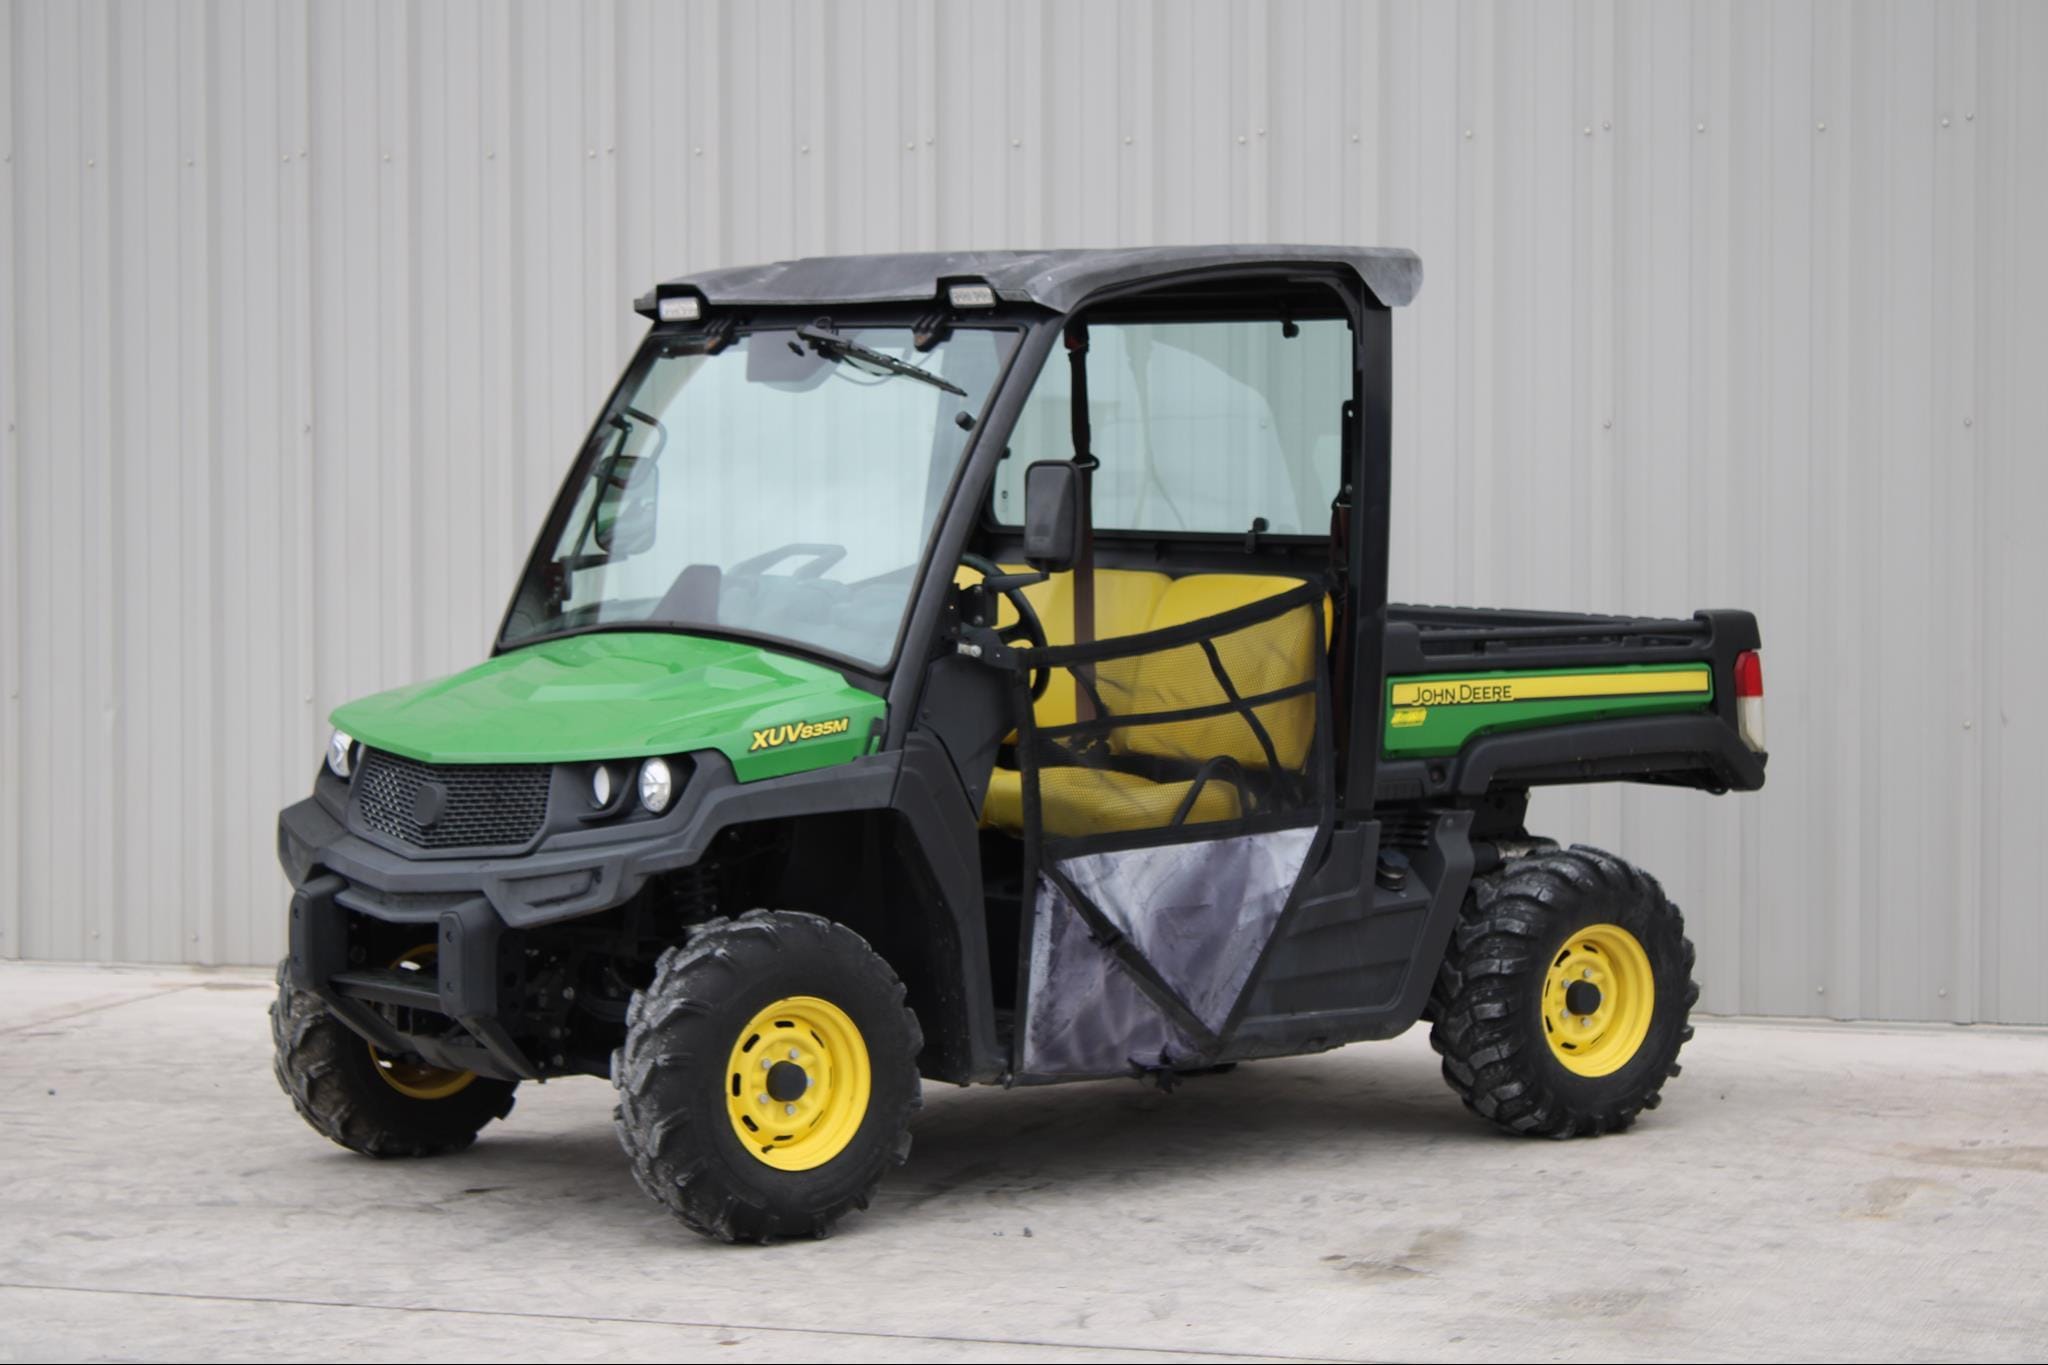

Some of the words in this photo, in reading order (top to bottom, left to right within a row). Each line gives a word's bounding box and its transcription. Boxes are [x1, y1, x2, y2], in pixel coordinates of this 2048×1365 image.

[1412, 686, 1456, 703] JOHN
[1460, 685, 1512, 701] DEERE
[750, 718, 849, 751] XUV835M
